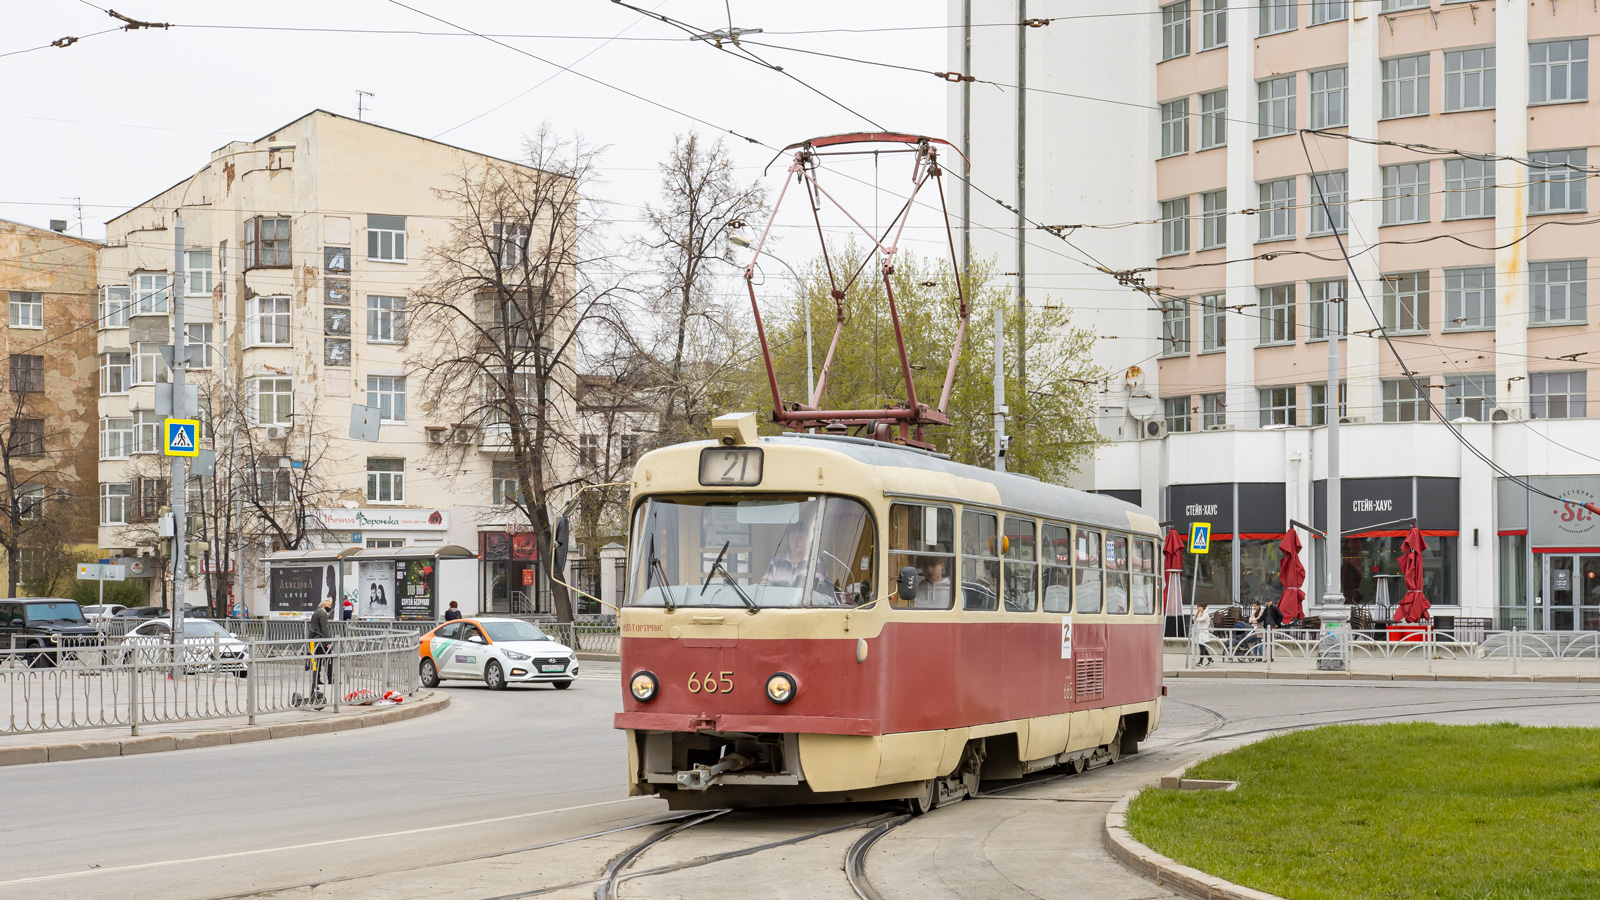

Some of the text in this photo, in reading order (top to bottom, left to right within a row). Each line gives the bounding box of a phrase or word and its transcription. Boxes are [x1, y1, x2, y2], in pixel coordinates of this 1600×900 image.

[720, 450, 749, 481] 21
[1185, 504, 1218, 516] СТЕЙК-ХАУС
[1354, 498, 1393, 512] СТЕЙК-ХАУС
[1063, 623, 1071, 643] 2
[687, 671, 734, 694] 665
[1063, 682, 1073, 700] 665
